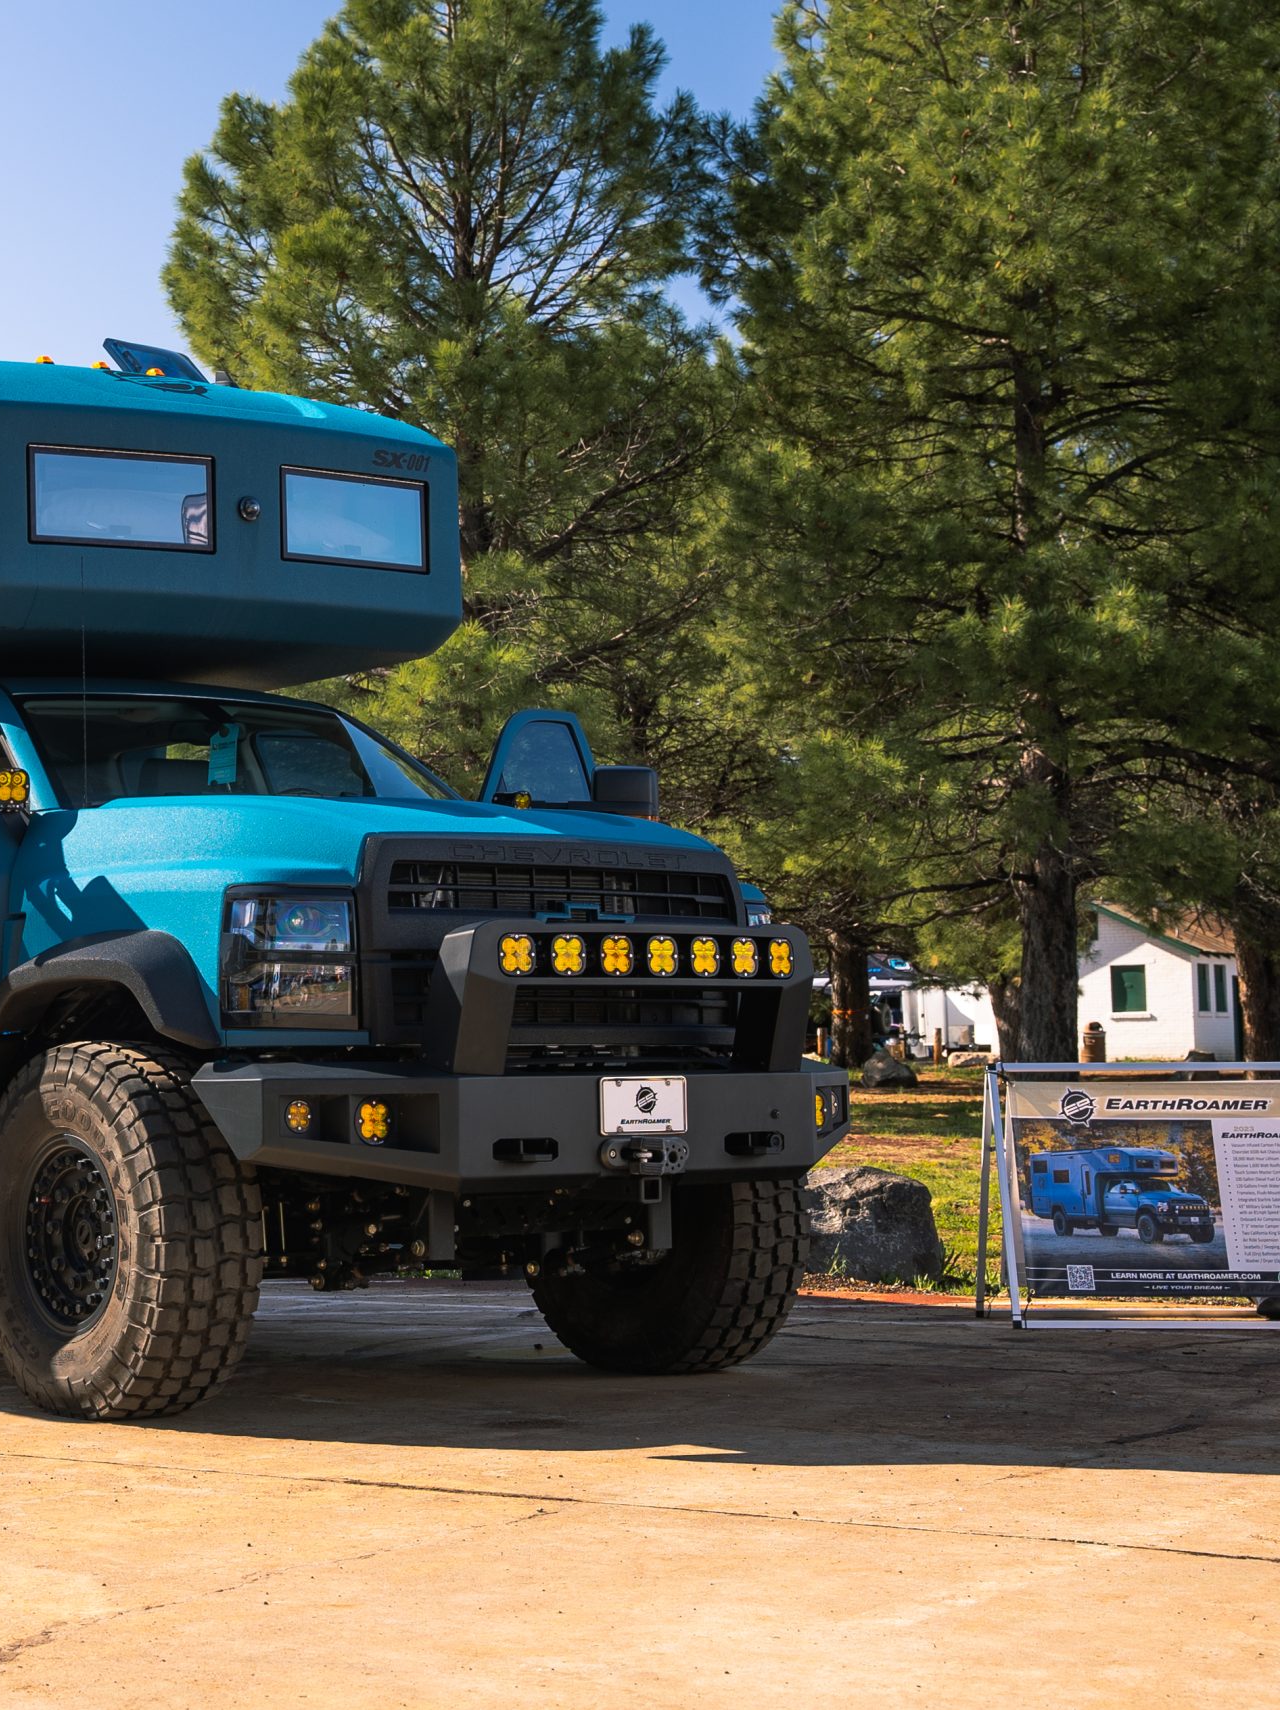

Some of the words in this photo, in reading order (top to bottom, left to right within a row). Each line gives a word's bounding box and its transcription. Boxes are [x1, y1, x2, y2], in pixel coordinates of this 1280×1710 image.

[372, 449, 432, 473] SX-001
[448, 843, 688, 870] CHEVROLET
[1105, 1098, 1268, 1111] EARTHROAMER
[1140, 1272, 1164, 1280] MORE
